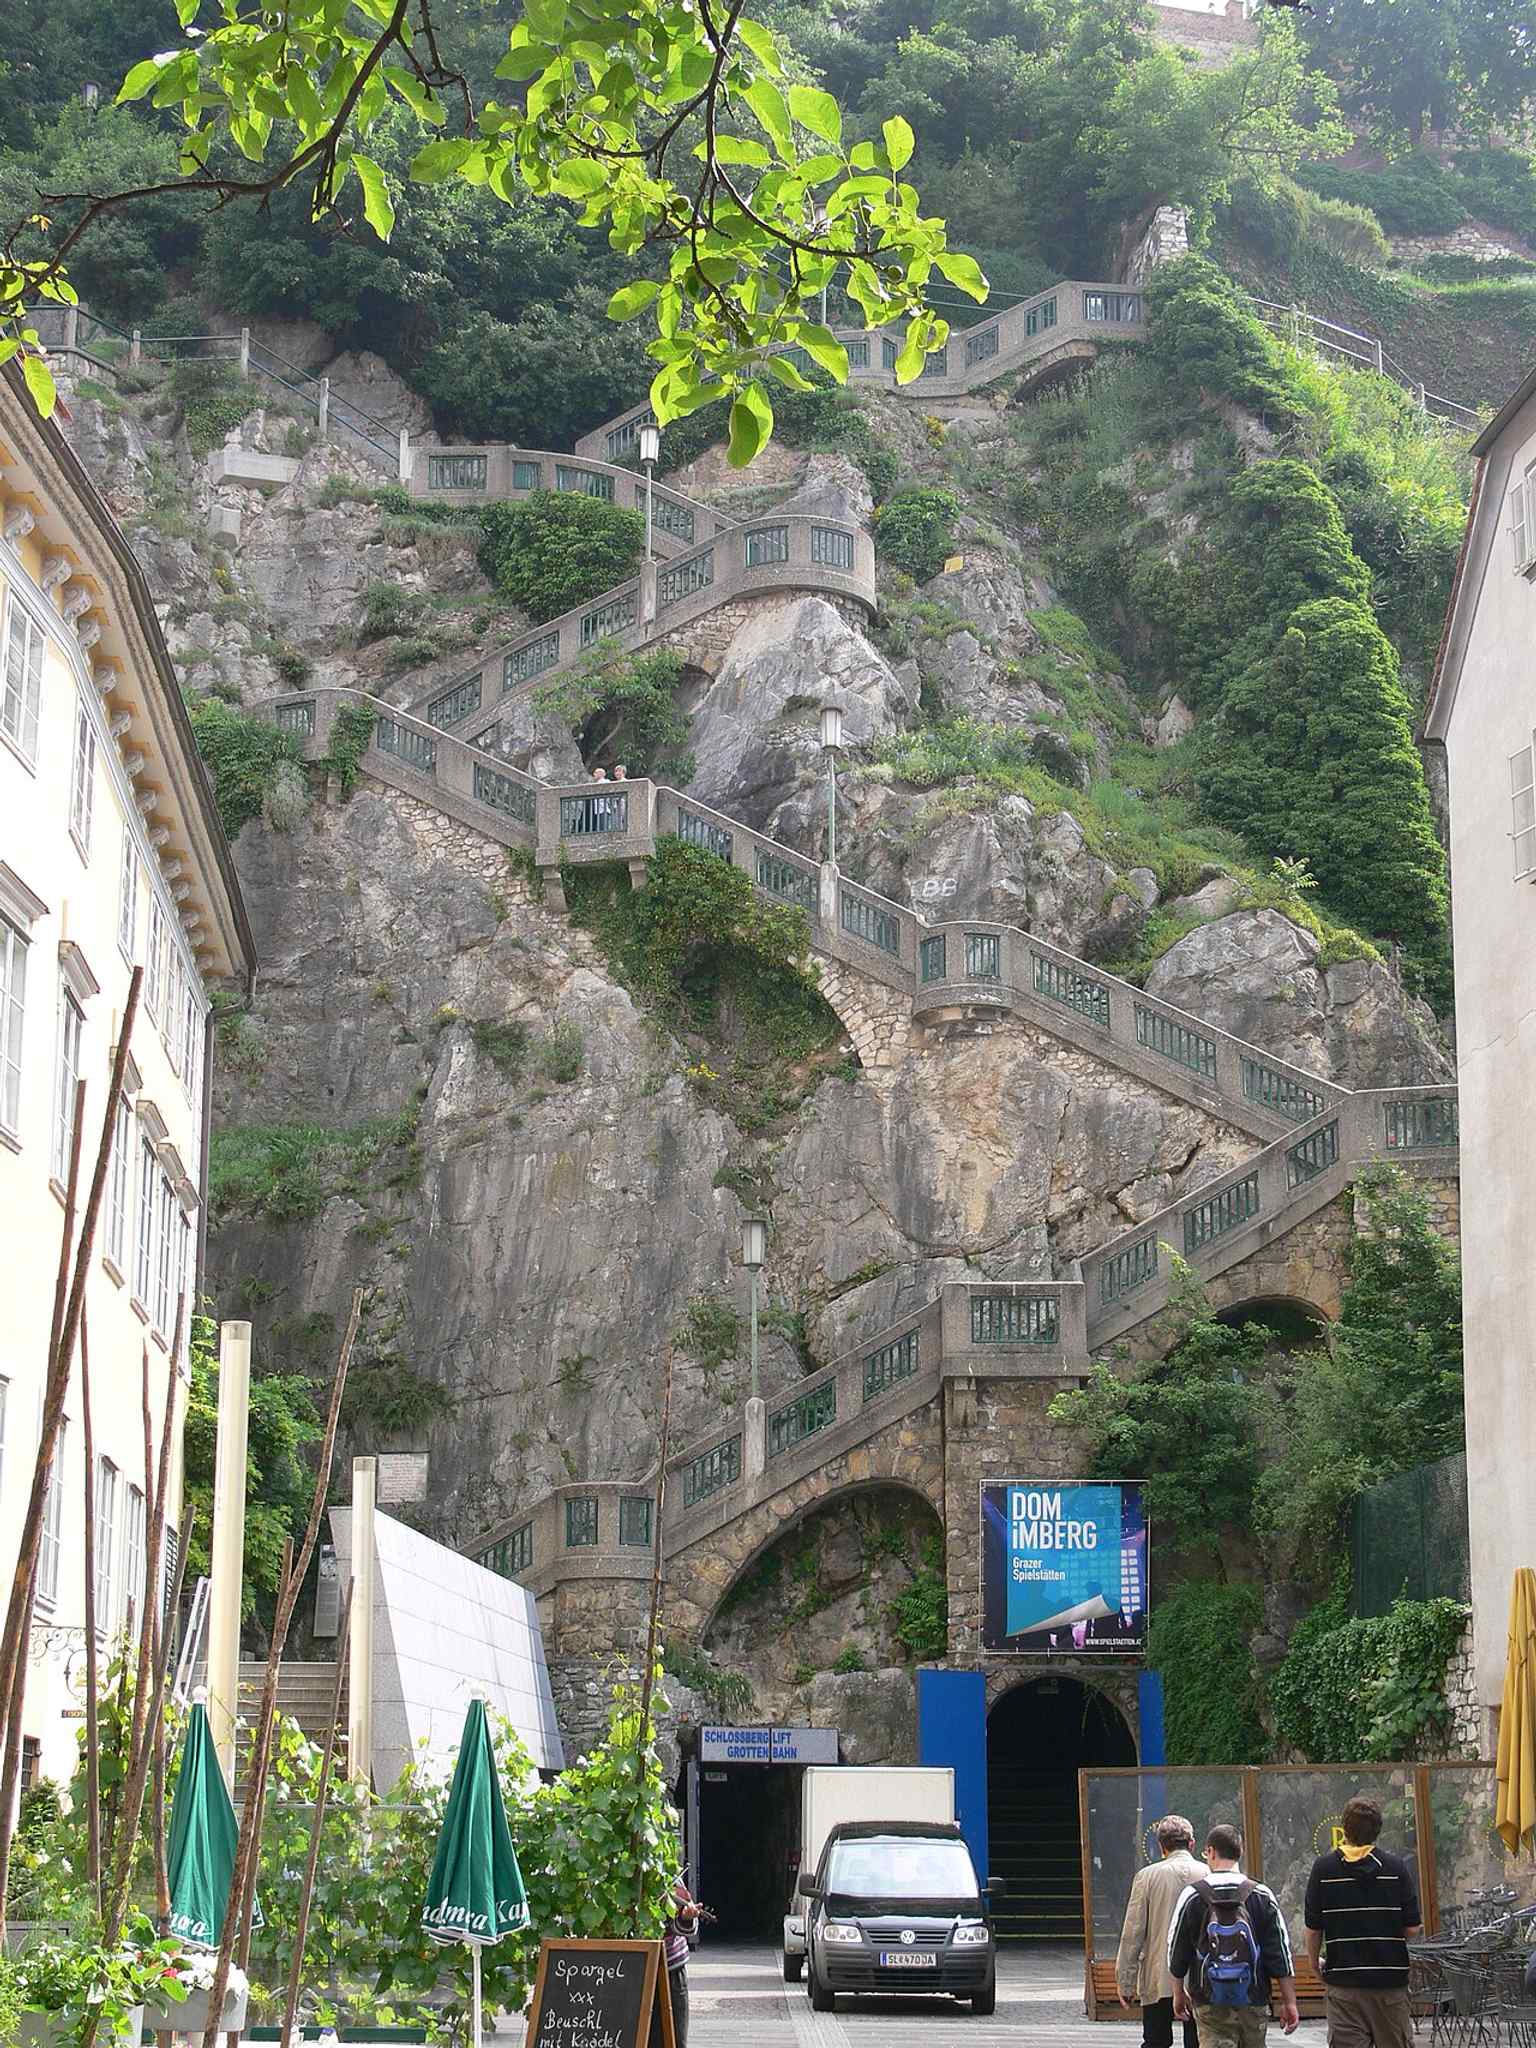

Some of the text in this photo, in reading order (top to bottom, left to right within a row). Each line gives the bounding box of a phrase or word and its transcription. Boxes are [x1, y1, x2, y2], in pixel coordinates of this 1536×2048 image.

[1012, 1492, 1061, 1520] DOM
[1012, 1556, 1043, 1569] Grazer
[1012, 1569, 1066, 1582] Spielstätten
[555, 1959, 625, 1986] Spargel
[543, 2008, 602, 2030] Beuschl
